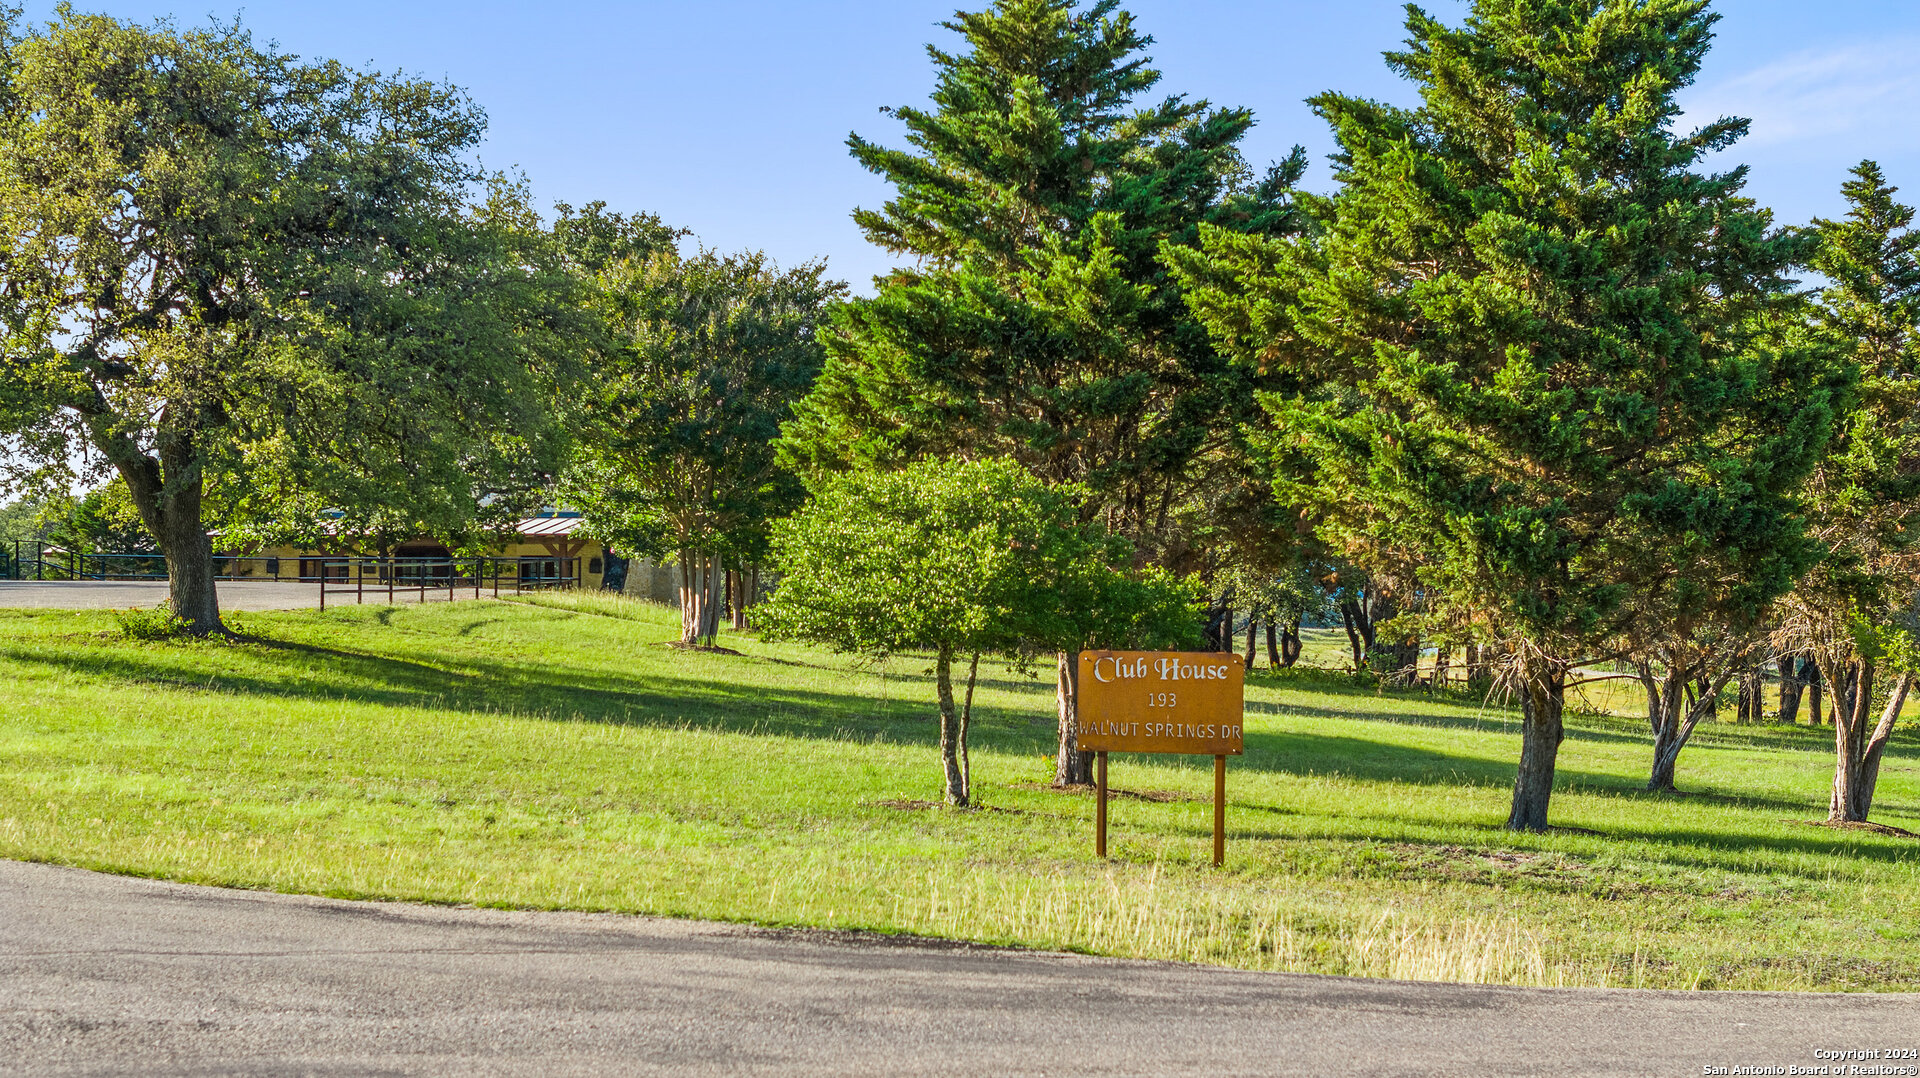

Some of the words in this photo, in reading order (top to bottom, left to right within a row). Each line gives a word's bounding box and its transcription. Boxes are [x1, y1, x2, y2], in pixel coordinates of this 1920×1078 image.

[1094, 656, 1147, 683] Club
[1154, 658, 1229, 681] House
[1148, 692, 1177, 707] 193
[1079, 720, 1139, 737] WALNUT
[1145, 722, 1216, 739] SPRINGS
[1221, 724, 1241, 740] DR
